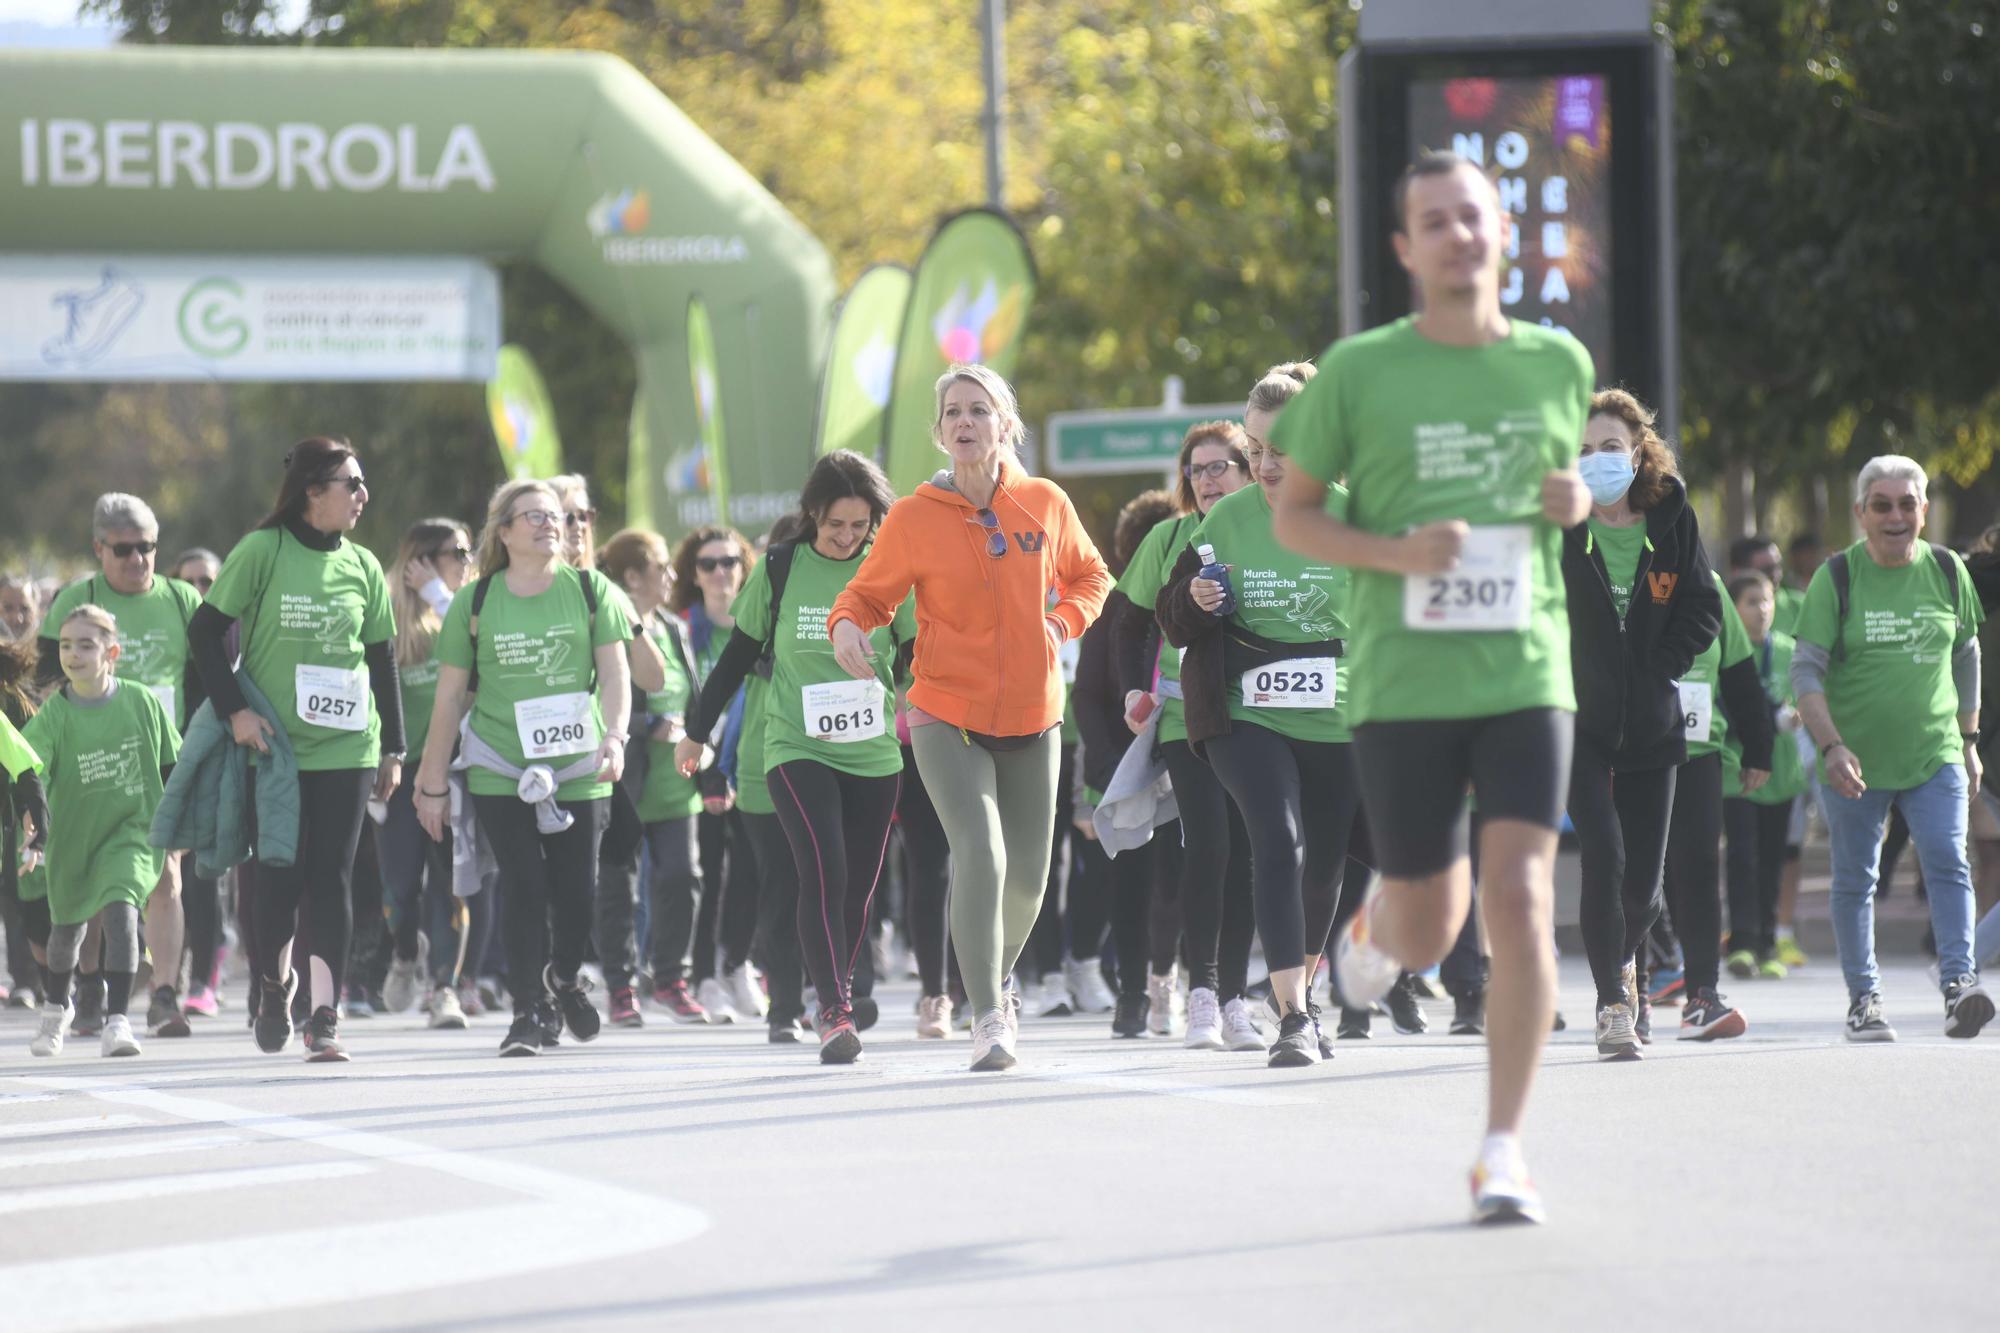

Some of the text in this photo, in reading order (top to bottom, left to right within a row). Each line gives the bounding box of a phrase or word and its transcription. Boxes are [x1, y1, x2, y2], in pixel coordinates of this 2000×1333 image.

[20, 118, 496, 192] IBERDROLA
[603, 234, 748, 266] IBERDROLA
[1243, 569, 1277, 578] Murcia
[1243, 579, 1297, 589] en marcha
[1243, 589, 1275, 599] contra
[1428, 577, 1516, 608] 2307
[281, 593, 312, 604] Murcia
[1244, 598, 1291, 608] el cáncer
[281, 603, 329, 613] en marcha
[798, 606, 831, 615] Murcia
[281, 612, 310, 621] contra
[280, 620, 321, 629] el cáncer
[494, 632, 526, 643] Murcia
[796, 631, 807, 640] el
[495, 638, 544, 651] en marcha
[497, 648, 527, 658] contra
[508, 655, 540, 666] cáncer
[1256, 671, 1324, 693] 0523
[308, 694, 357, 718] 0257
[818, 708, 874, 733] 0613
[1685, 712, 1698, 728] 6
[532, 723, 584, 746] 0260
